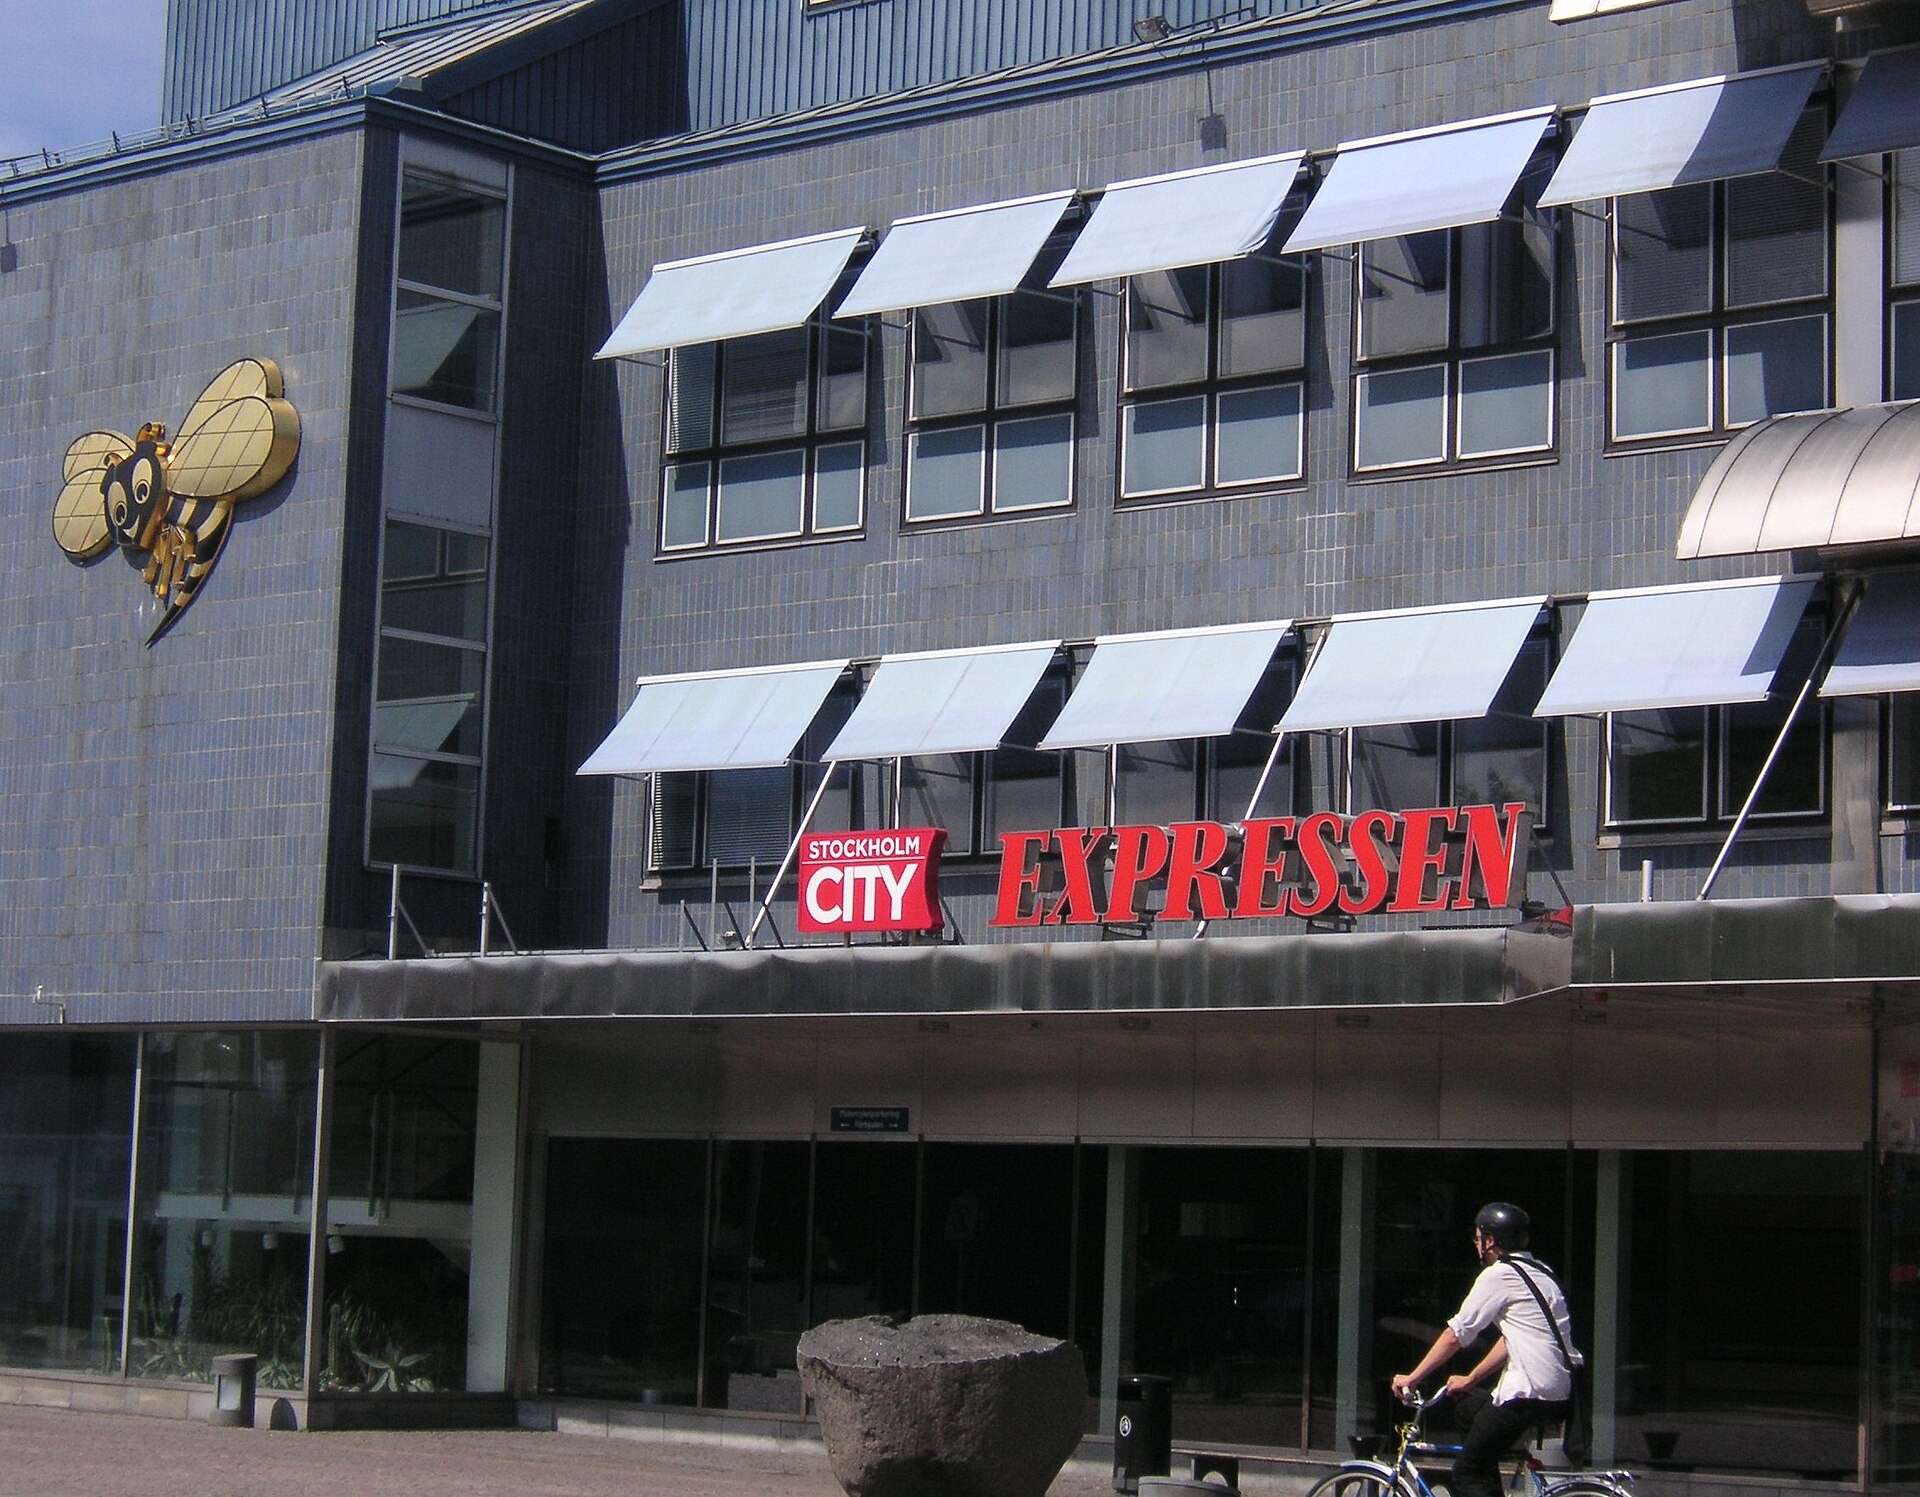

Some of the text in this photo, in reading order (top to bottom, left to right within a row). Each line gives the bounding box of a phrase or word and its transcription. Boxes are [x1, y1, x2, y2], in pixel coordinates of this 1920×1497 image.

[808, 836, 920, 859] STOCKHOLM
[988, 801, 1526, 927] EXPRESSEN
[805, 863, 919, 924] CITY
